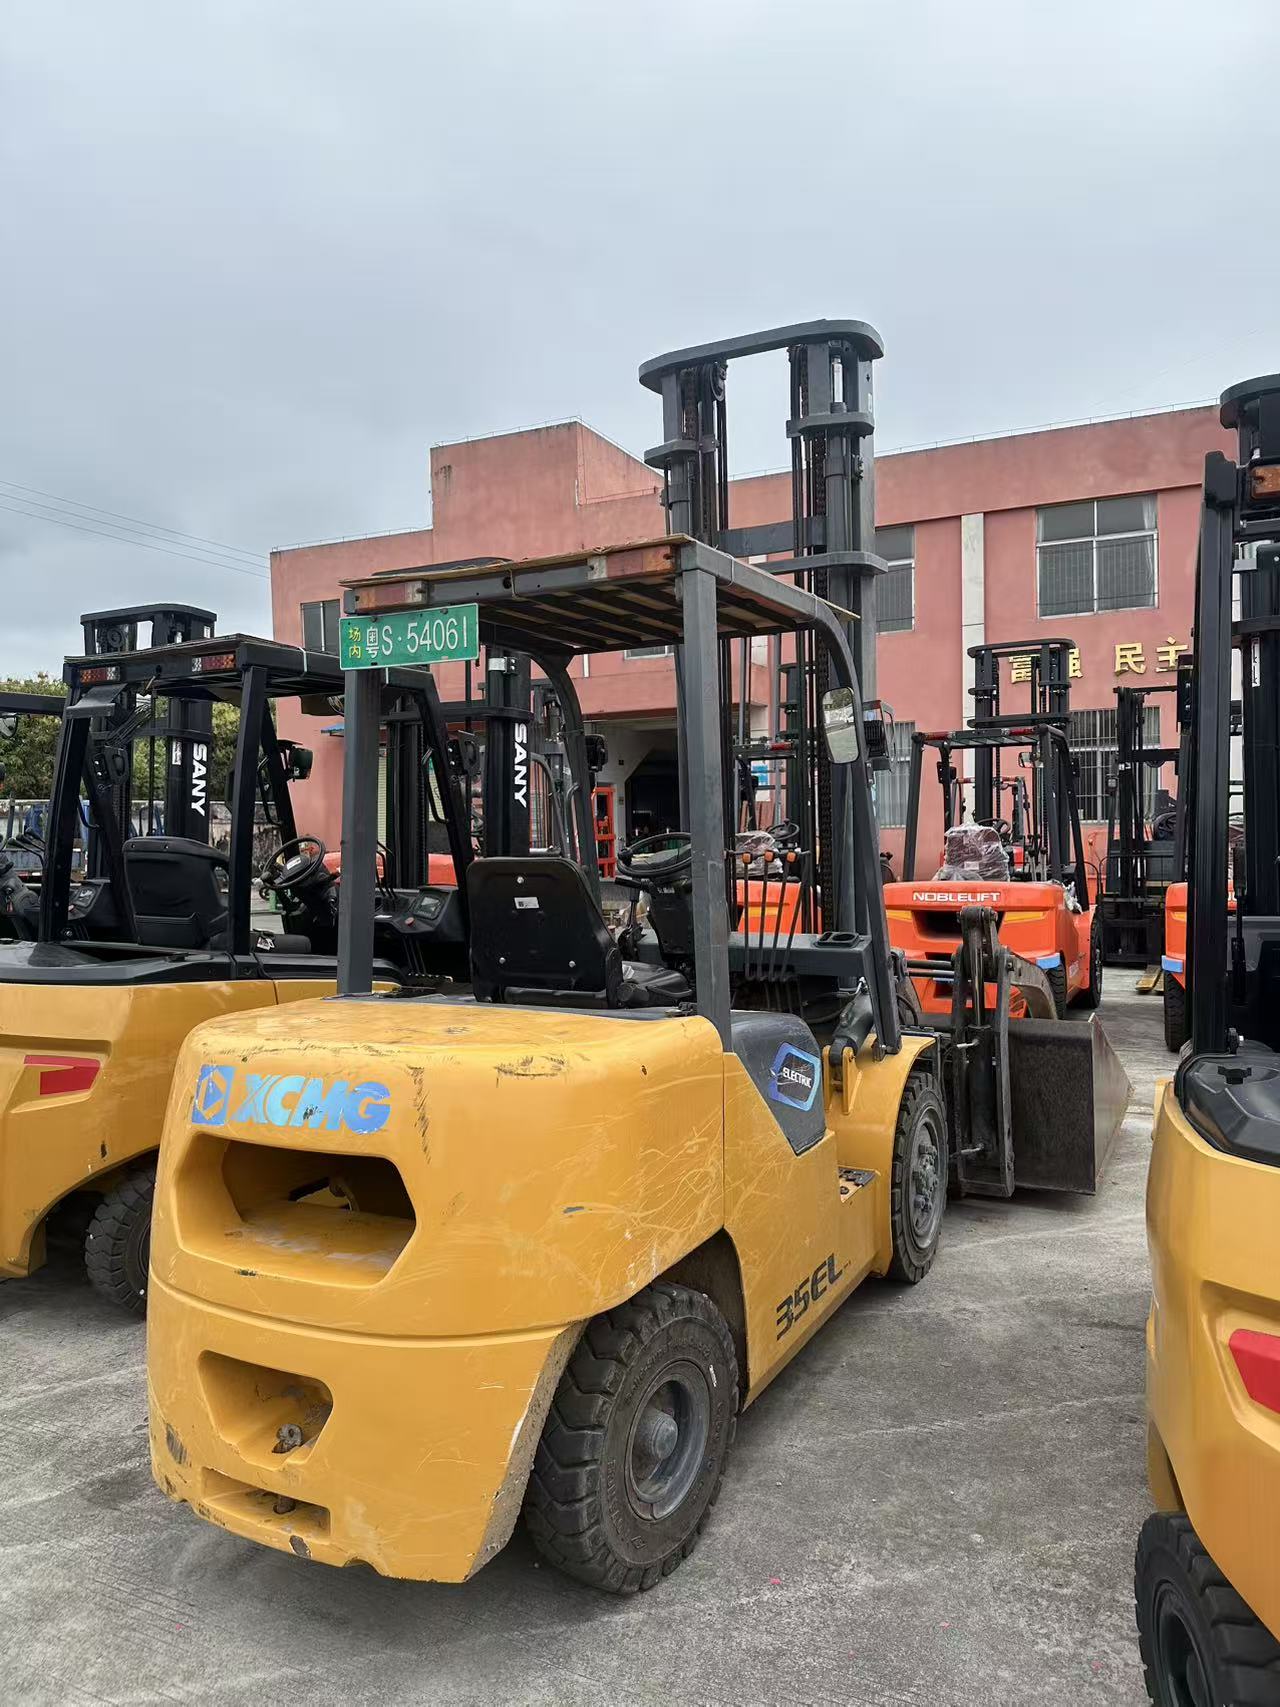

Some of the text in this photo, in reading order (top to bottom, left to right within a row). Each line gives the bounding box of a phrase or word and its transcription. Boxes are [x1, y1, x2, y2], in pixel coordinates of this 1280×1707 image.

[348, 626, 361, 658] 场内
[1114, 636, 1190, 676] 民主
[191, 743, 208, 816] SANY
[513, 722, 527, 808] SANY
[912, 892, 1001, 902] NOBLELIFT
[782, 1066, 812, 1088] ELECTRIC
[231, 1073, 391, 1135] XCMG
